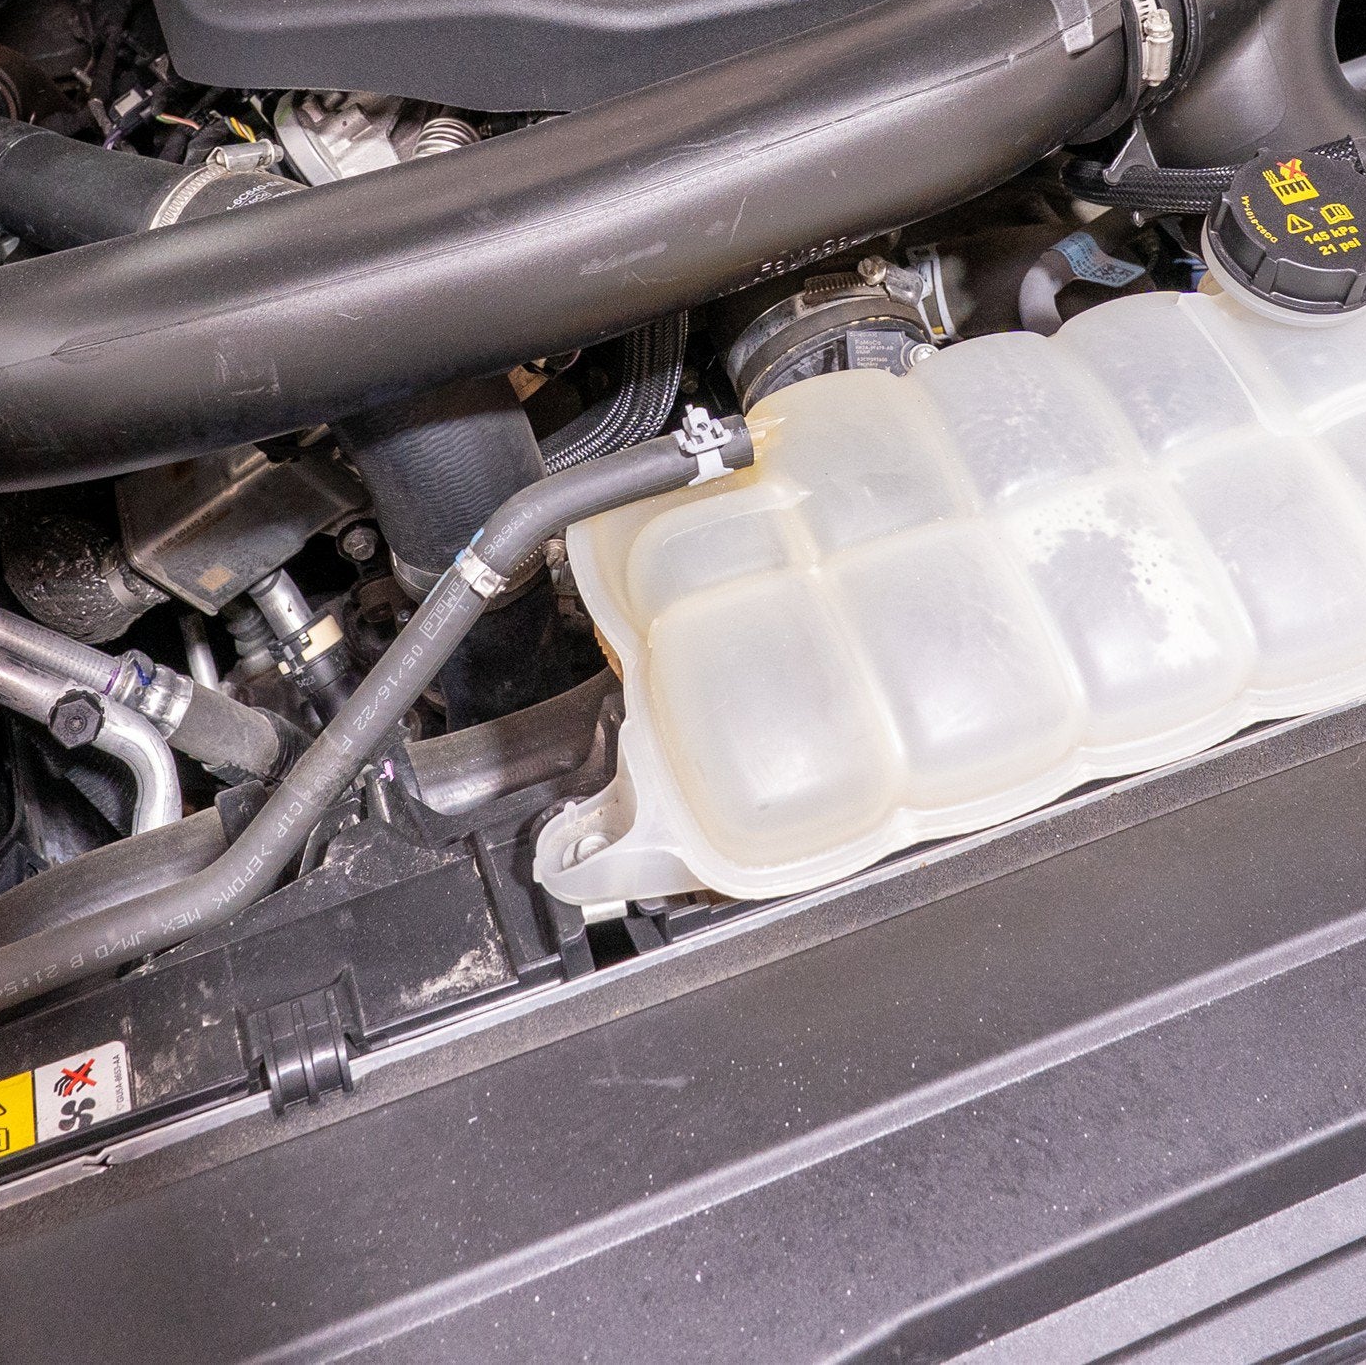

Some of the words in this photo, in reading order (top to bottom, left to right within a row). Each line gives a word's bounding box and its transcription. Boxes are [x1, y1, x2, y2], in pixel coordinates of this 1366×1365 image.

[1304, 231, 1330, 245] 145
[1330, 225, 1359, 238] kPa
[1318, 243, 1338, 256] 21
[1339, 237, 1362, 253] psi
[353, 643, 424, 731] 05/16/22
[277, 801, 304, 839] CIP
[161, 907, 202, 936] MEX
